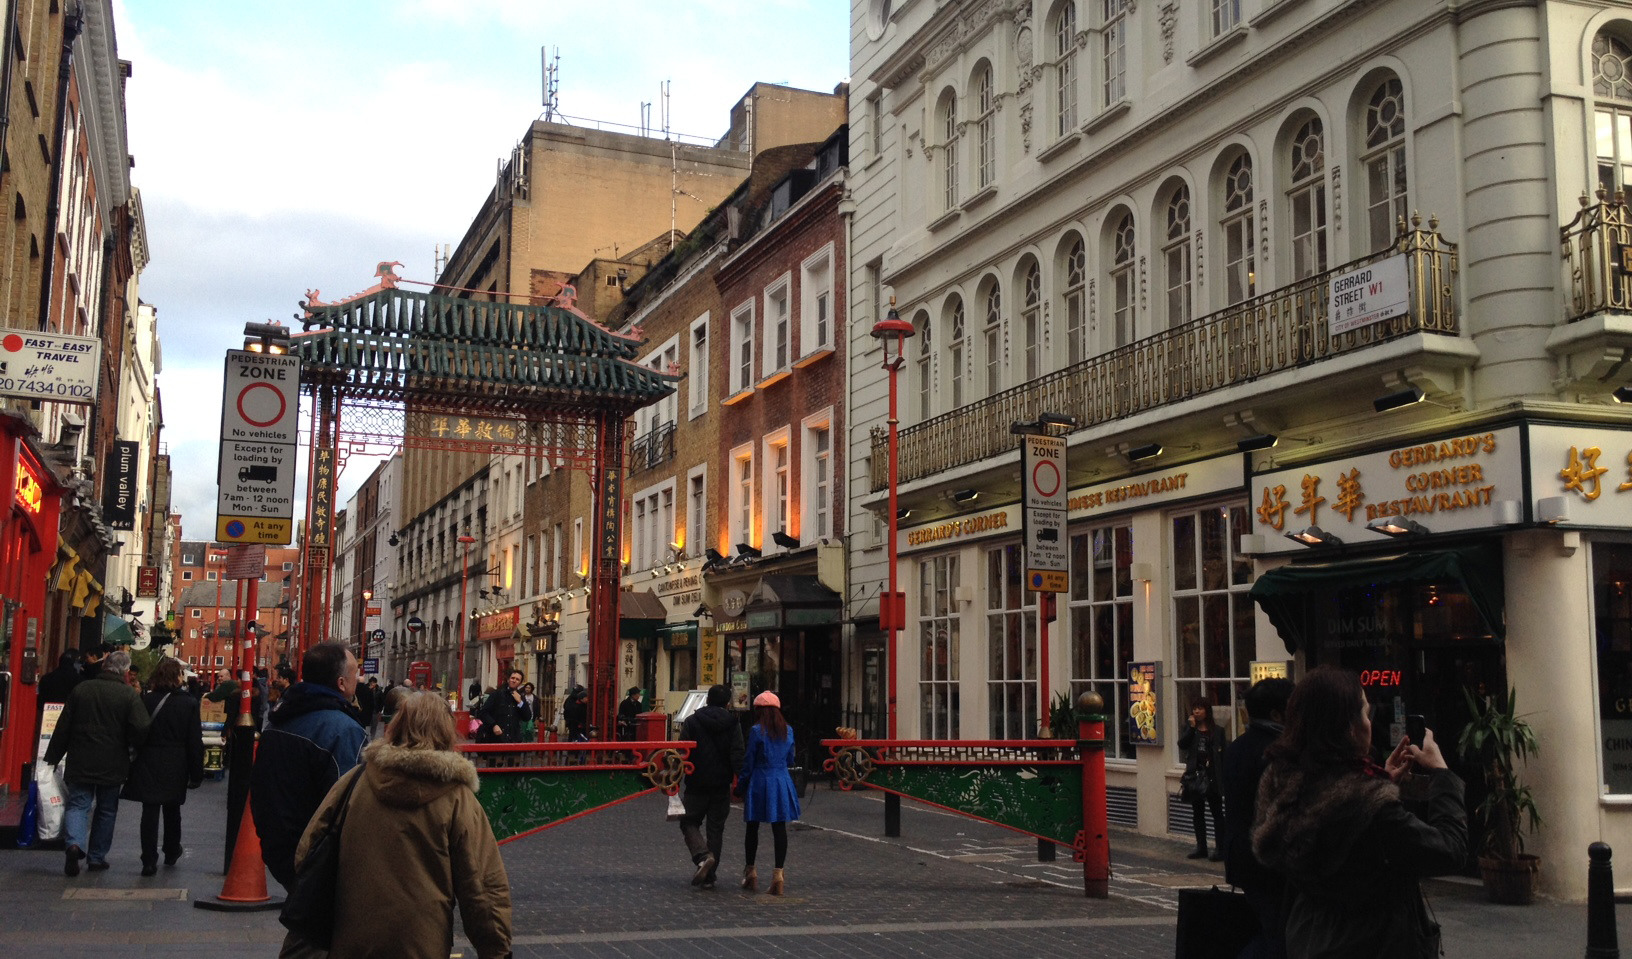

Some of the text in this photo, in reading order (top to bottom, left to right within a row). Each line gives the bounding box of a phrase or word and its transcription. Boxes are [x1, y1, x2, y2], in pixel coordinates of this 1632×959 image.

[1334, 270, 1372, 293] GERRARD
[1334, 282, 1383, 308] STREET W1
[24, 338, 54, 348] FAST
[62, 342, 92, 352] EASY
[36, 352, 80, 363] TRAVEL
[231, 354, 296, 367] PEDESTRIAN
[240, 366, 286, 380] ZONE
[18, 380, 54, 394] 7434
[57, 383, 92, 398] 0102
[232, 428, 287, 439] No vehicles
[234, 444, 284, 454] Except for
[1028, 437, 1064, 448] PEDESTRIAN
[1033, 447, 1060, 458] ZONE
[1388, 432, 1496, 470] GERRARD'S
[120, 446, 132, 473] plum
[234, 454, 283, 464] loading by
[1405, 463, 1483, 492] CORNER
[116, 476, 130, 510] valley
[236, 484, 277, 494] between
[224, 493, 244, 501] 7am
[253, 495, 264, 503] 12
[1256, 467, 1365, 532] 好年華
[1364, 484, 1496, 521] RESTAURANT
[232, 504, 252, 512] Mon
[260, 505, 279, 513] Sun
[908, 521, 960, 546] GERRARD'S
[963, 511, 1008, 534] CORNER
[1105, 472, 1188, 504] RESTAURANT
[268, 523, 284, 531] any
[1033, 519, 1052, 527] loading
[1327, 616, 1387, 634] DIM SUM
[1346, 639, 1363, 647] DAILY
[1360, 670, 1402, 686] OPEN
